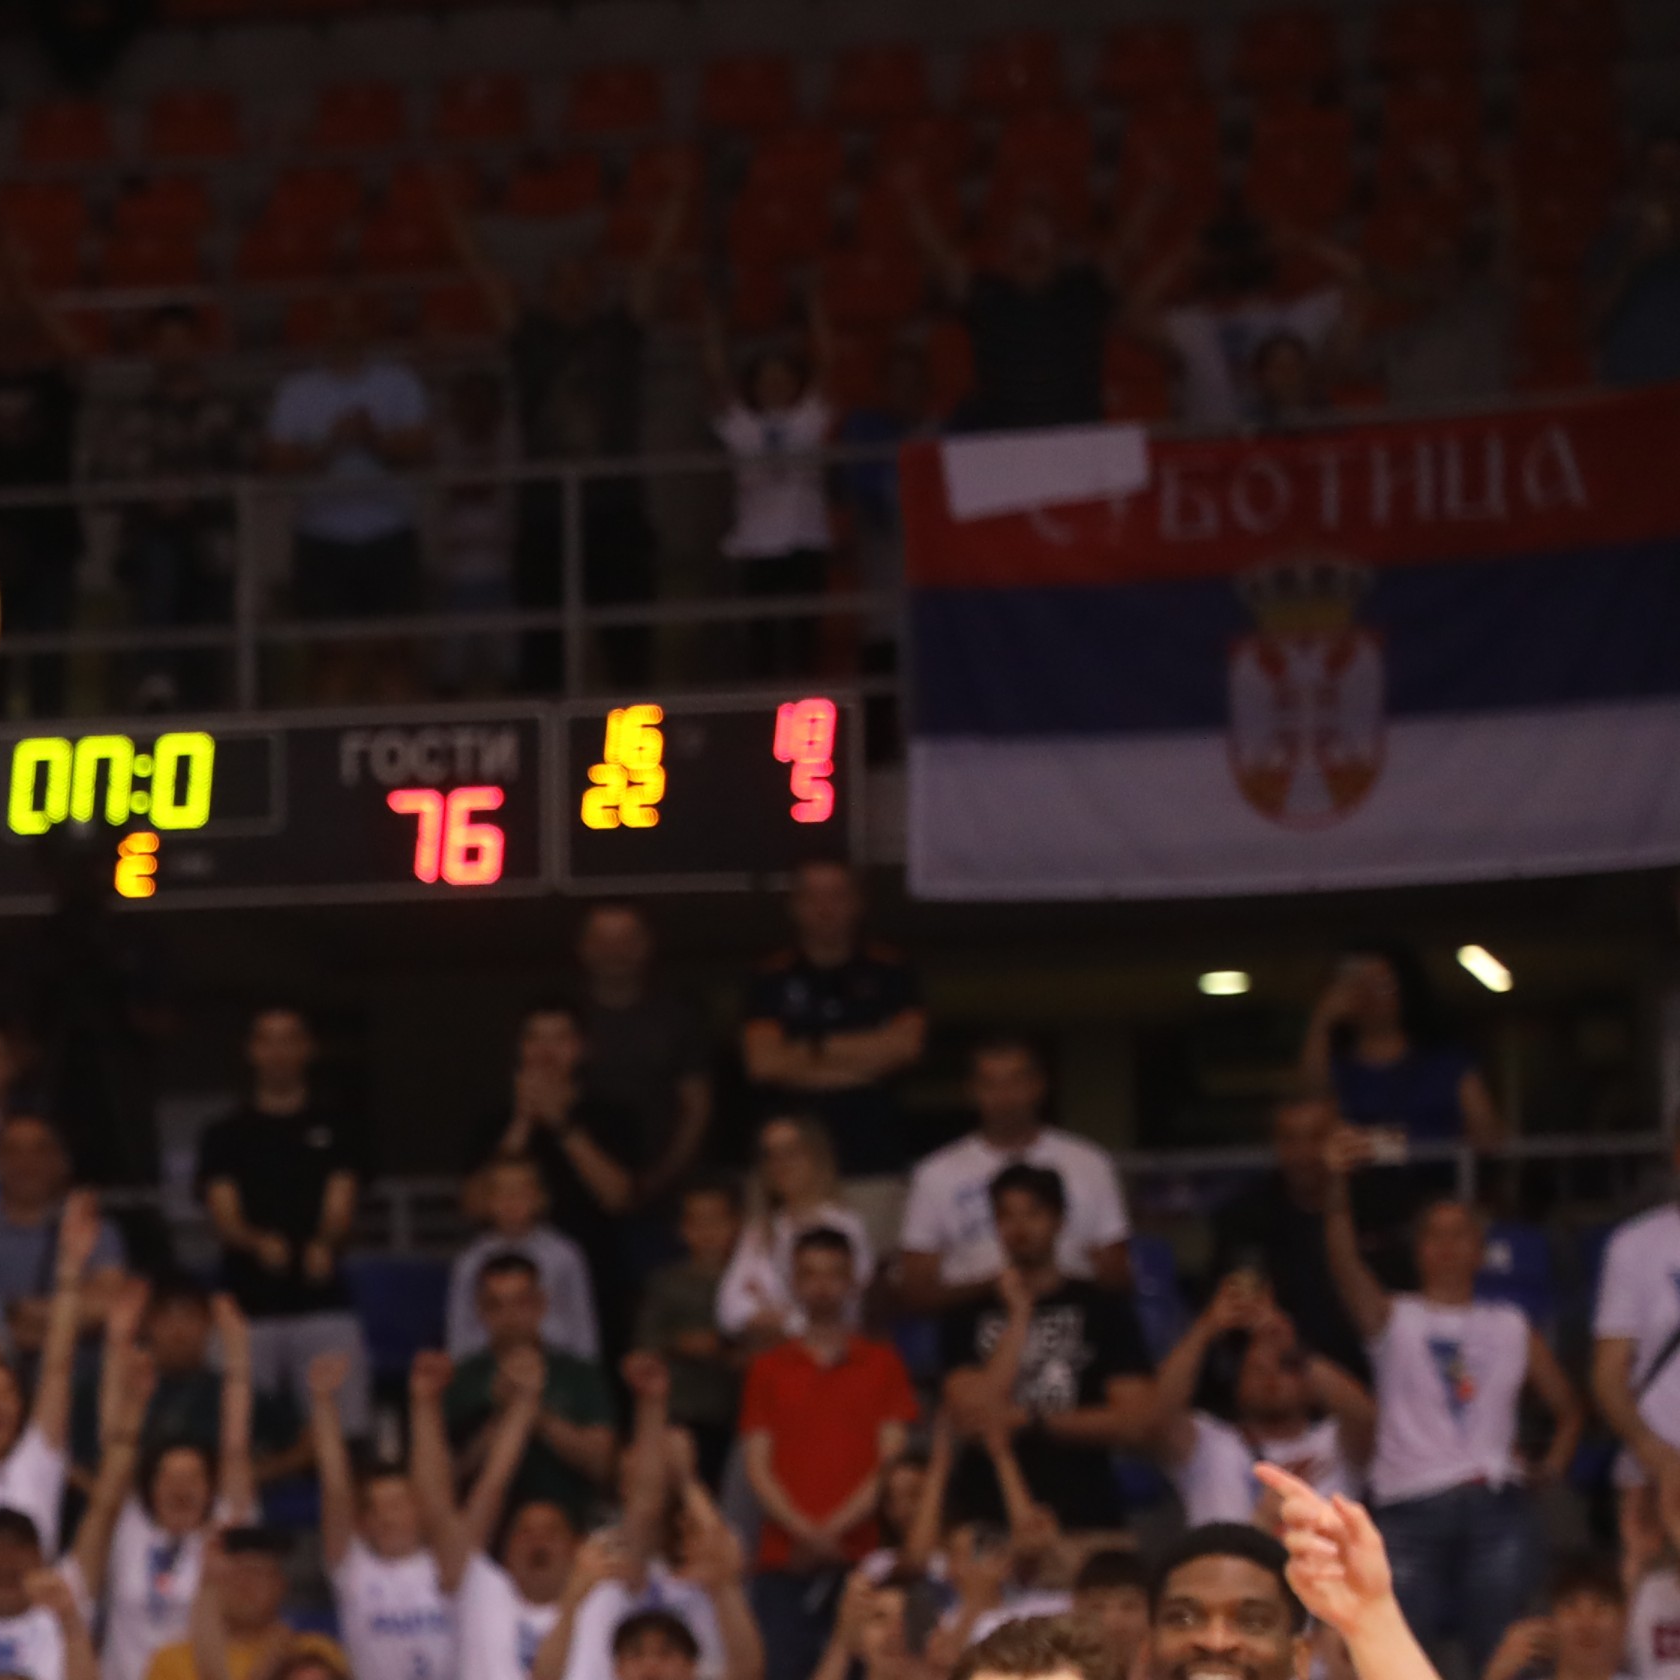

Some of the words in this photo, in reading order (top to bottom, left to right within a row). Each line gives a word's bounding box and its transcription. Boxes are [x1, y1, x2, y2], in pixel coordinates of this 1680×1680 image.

[1030, 421, 1590, 548] БОТИЦА
[342, 726, 521, 787] ГОСТИ
[386, 786, 507, 886] 76
